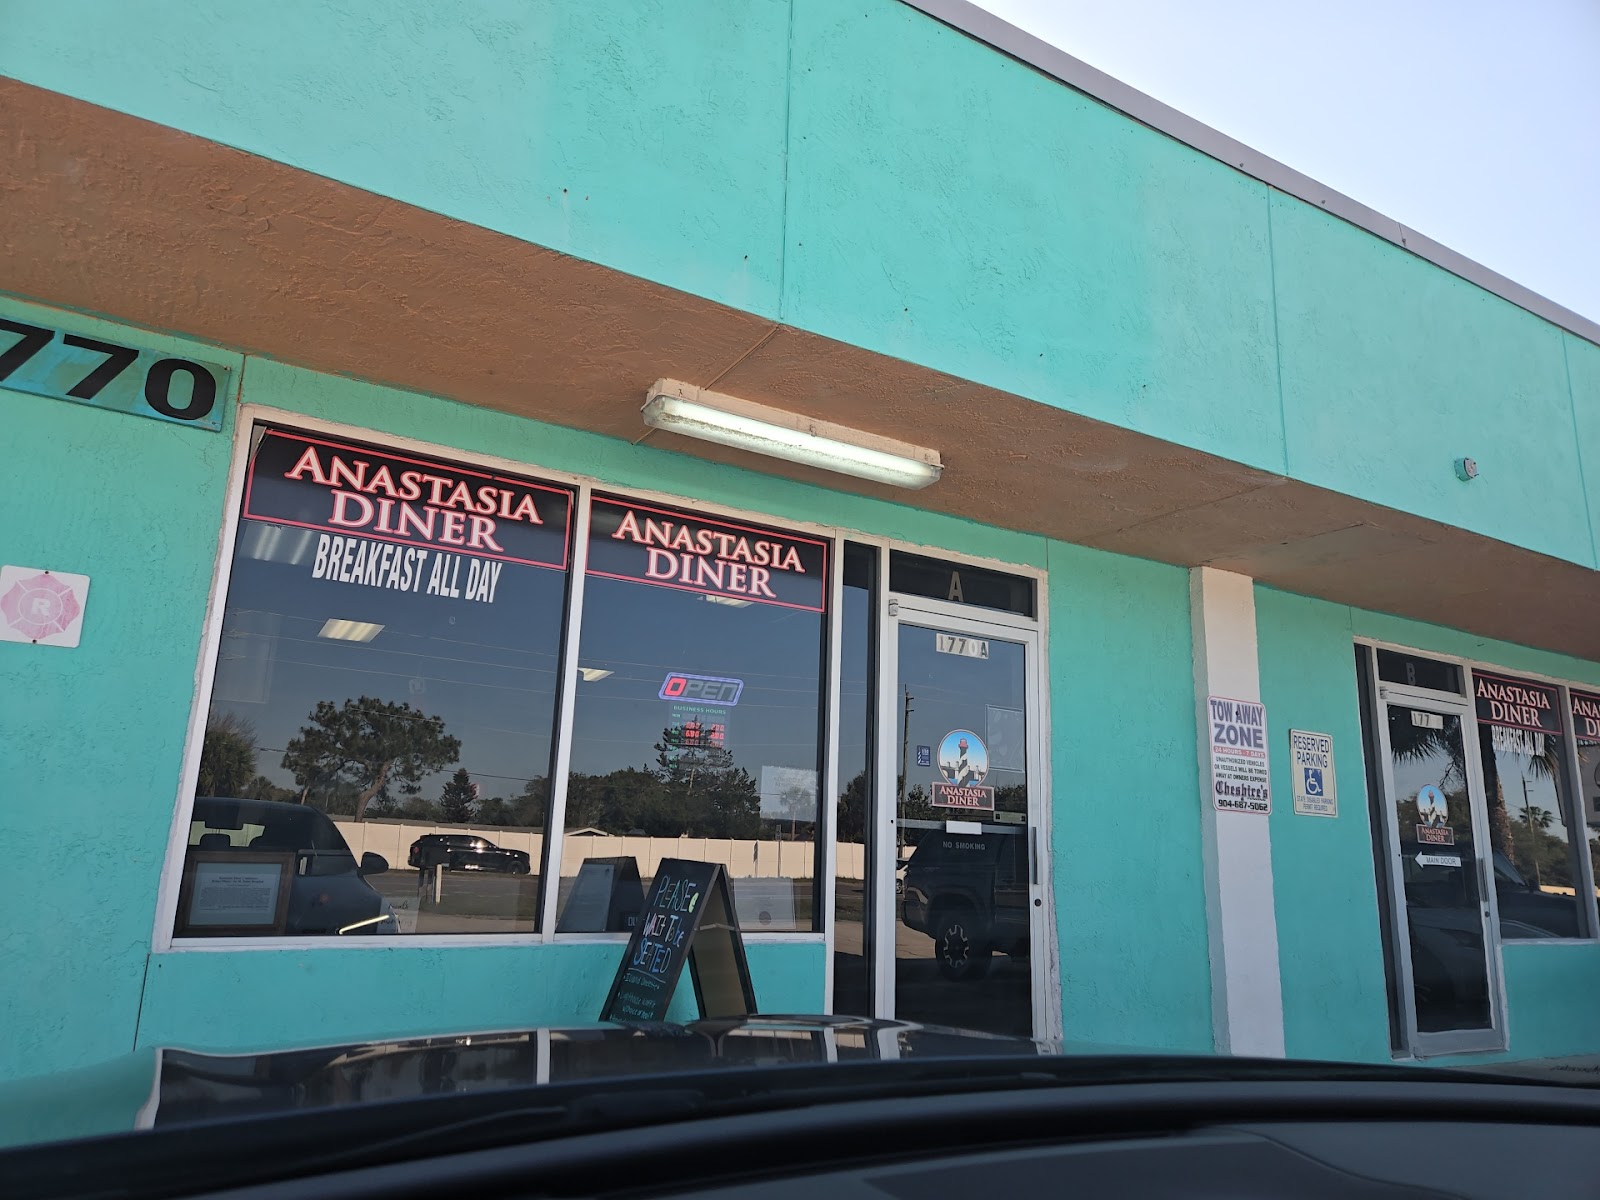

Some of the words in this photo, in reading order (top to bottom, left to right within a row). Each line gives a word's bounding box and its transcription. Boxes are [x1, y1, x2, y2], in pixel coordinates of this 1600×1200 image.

[284, 445, 544, 526] ANASTASIA
[328, 489, 504, 553] DINER
[612, 510, 806, 574] ANASTASIA
[312, 534, 429, 593] BREAKFAST
[427, 549, 461, 599] ALL
[464, 558, 503, 603] DAY
[645, 548, 777, 599] DINER
[948, 571, 964, 602] A
[32, 597, 51, 617] R
[1406, 663, 1416, 687] B
[664, 676, 738, 701] OPEN
[1476, 678, 1551, 710] ANASTASIA
[673, 705, 704, 713] BUSINESS
[1210, 700, 1233, 722] TOW
[1236, 704, 1263, 727] AWAY
[1490, 700, 1543, 728] DINER
[1573, 697, 1600, 719] ANA
[1214, 723, 1264, 749] ZONE
[1293, 734, 1330, 754] RESERVED
[1216, 756, 1246, 765] UNAUTHORIZED
[1246, 759, 1265, 767] VEHICLES
[1222, 747, 1242, 756] HOURS
[1296, 750, 1328, 769] PARKING
[1220, 764, 1238, 772] VESSELS
[1249, 775, 1267, 783] EXPENSE
[940, 786, 987, 798] ANASTASIA
[1215, 780, 1268, 800] Cheshire's
[947, 795, 980, 806] DINER
[1218, 799, 1268, 811] 904-687-5062
[1421, 827, 1449, 837] ANASTASIA
[1426, 833, 1446, 843] DINER
[943, 841, 953, 849] NO
[955, 842, 985, 850] SMOKING
[1426, 857, 1440, 865] MAIN
[1441, 857, 1456, 865] DOOR
[653, 875, 696, 912] PLEASE
